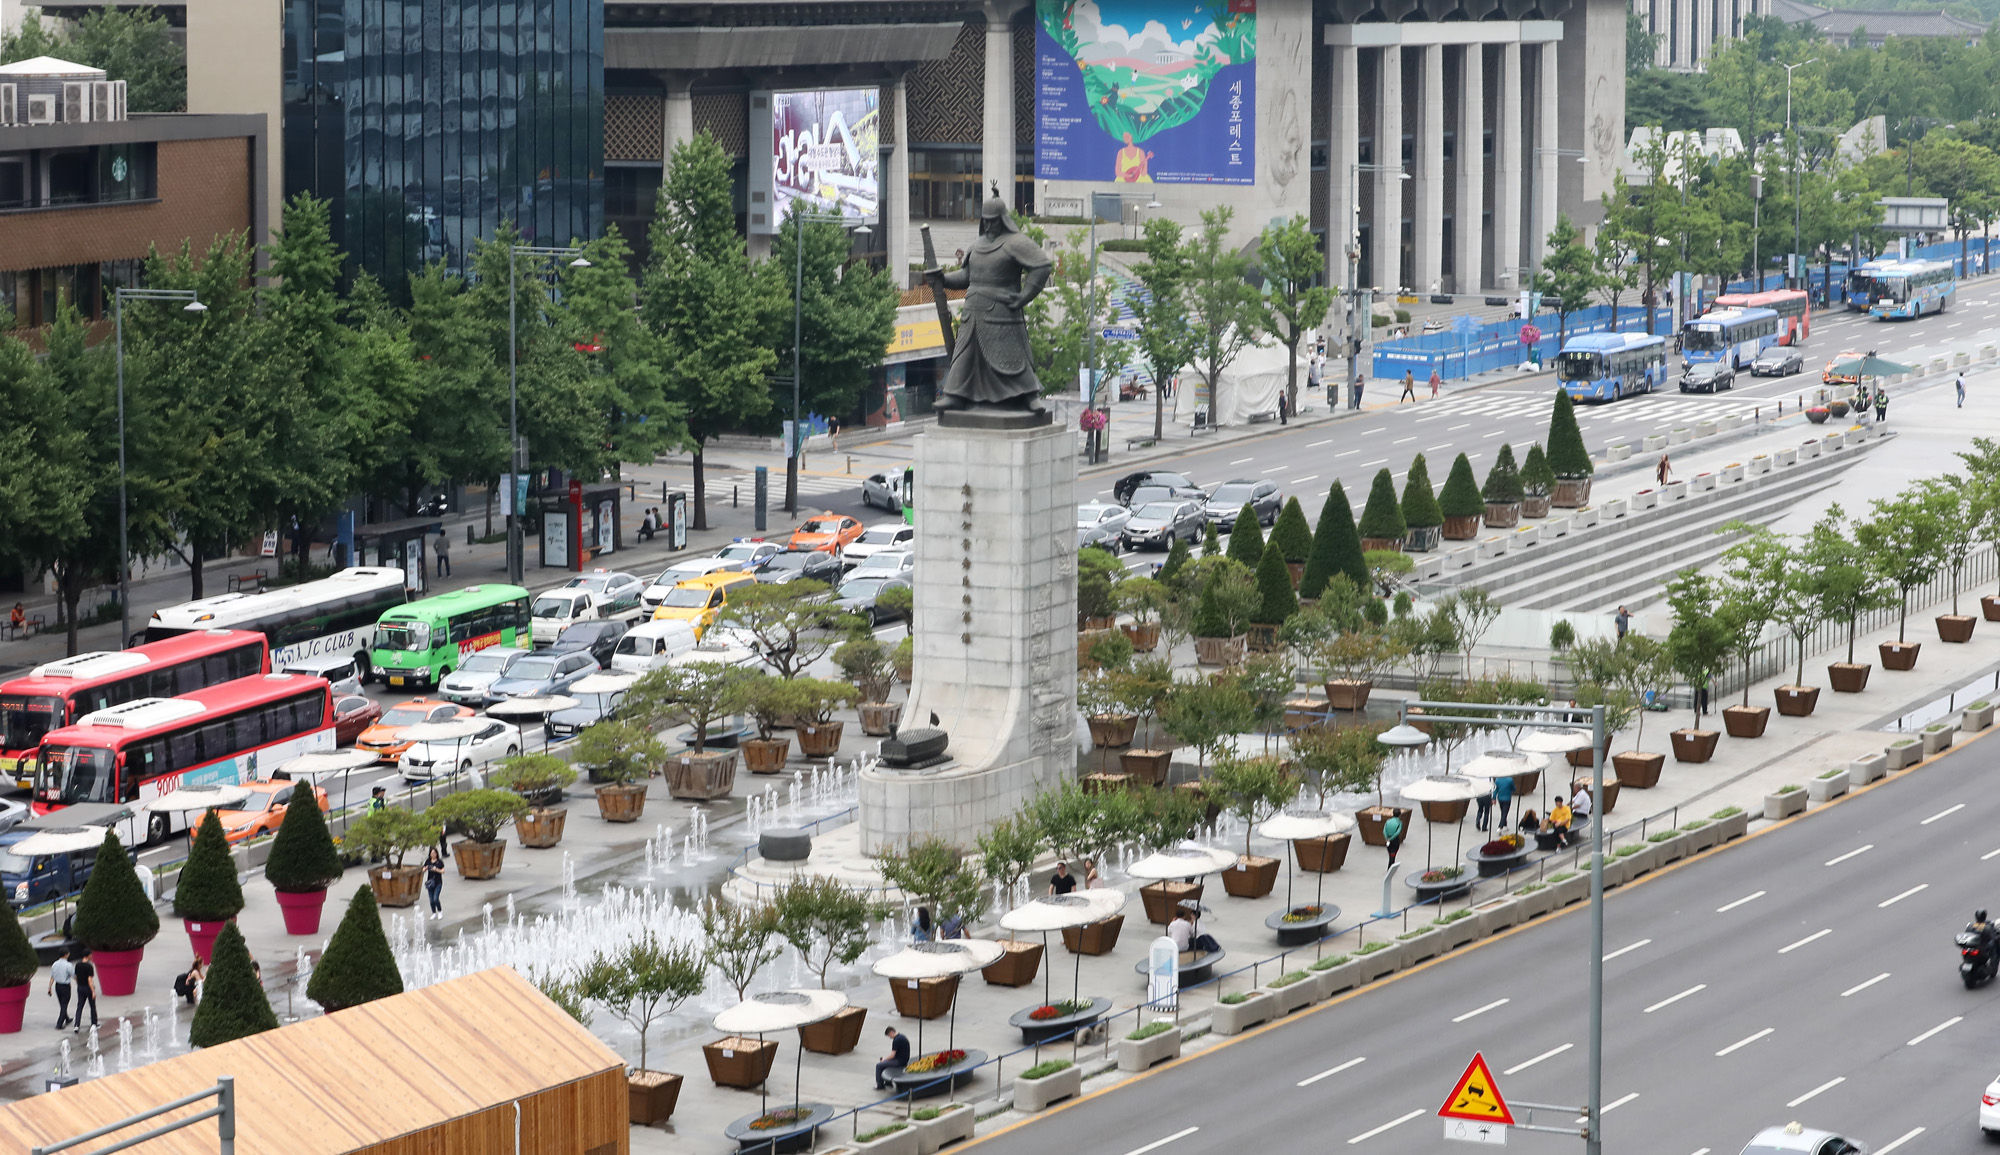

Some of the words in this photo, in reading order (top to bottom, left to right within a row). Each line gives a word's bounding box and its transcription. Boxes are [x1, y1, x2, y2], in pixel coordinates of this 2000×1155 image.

[1229, 80, 1242, 165] 세종포레스트
[325, 632, 354, 653] CLUB
[156, 774, 179, 797] 9000
